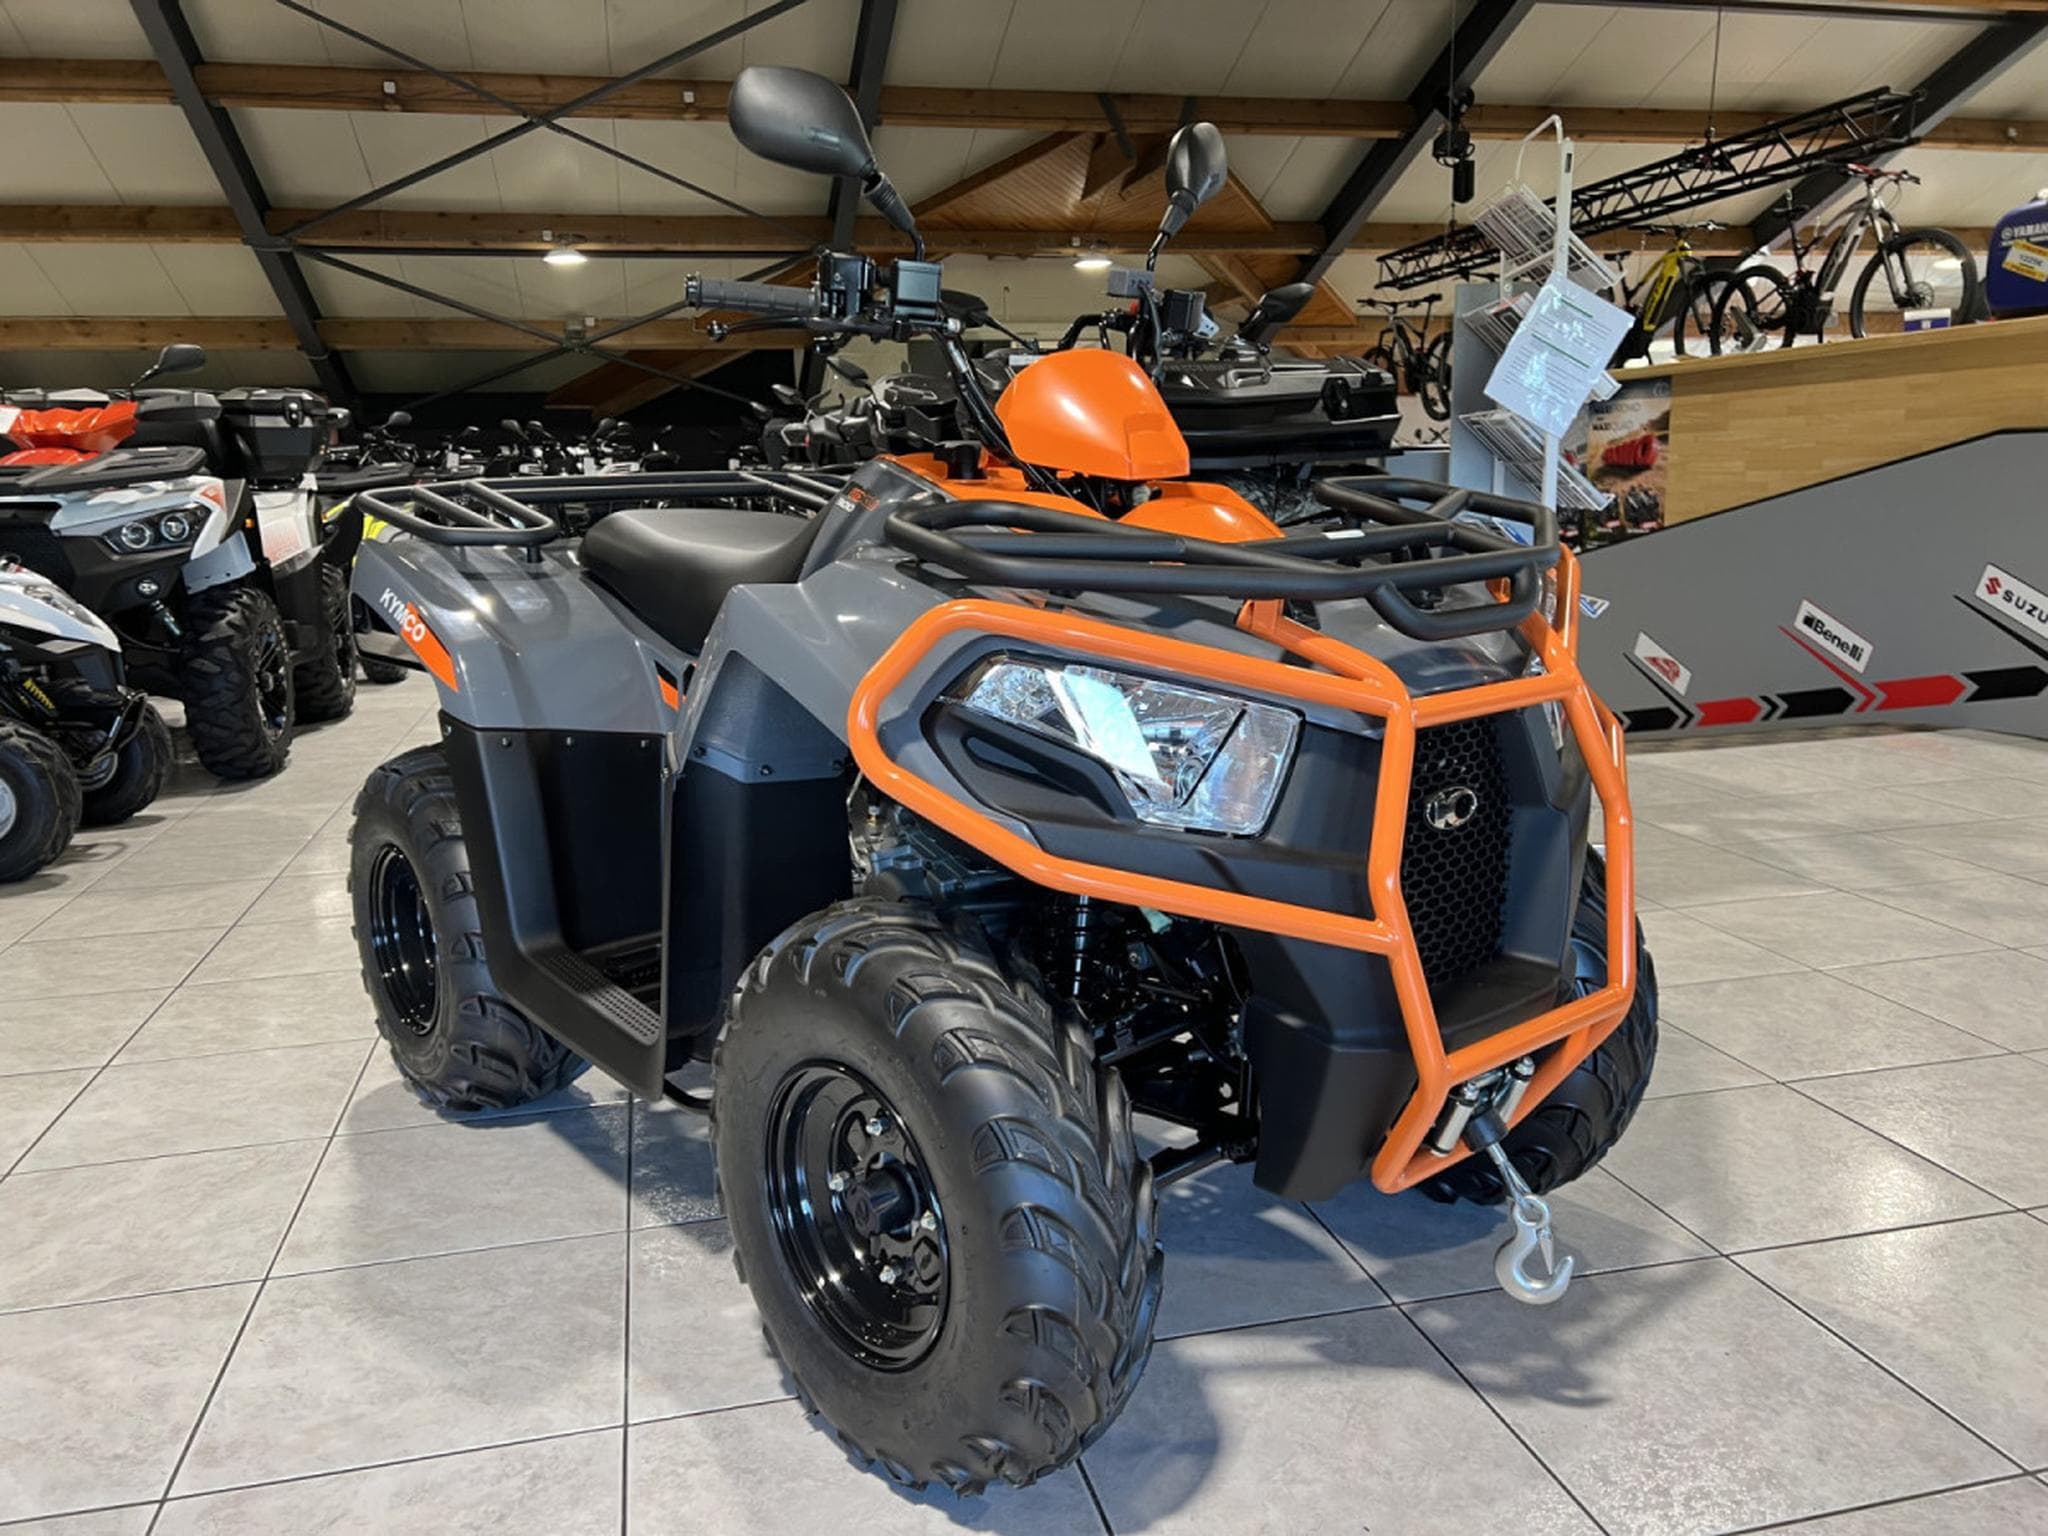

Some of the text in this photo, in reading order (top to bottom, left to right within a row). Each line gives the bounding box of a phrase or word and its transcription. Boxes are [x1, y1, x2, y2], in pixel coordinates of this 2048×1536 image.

[380, 587, 426, 642] KYMCO
[2002, 589, 2048, 624] SUZU
[1813, 619, 1864, 662] Benelli
